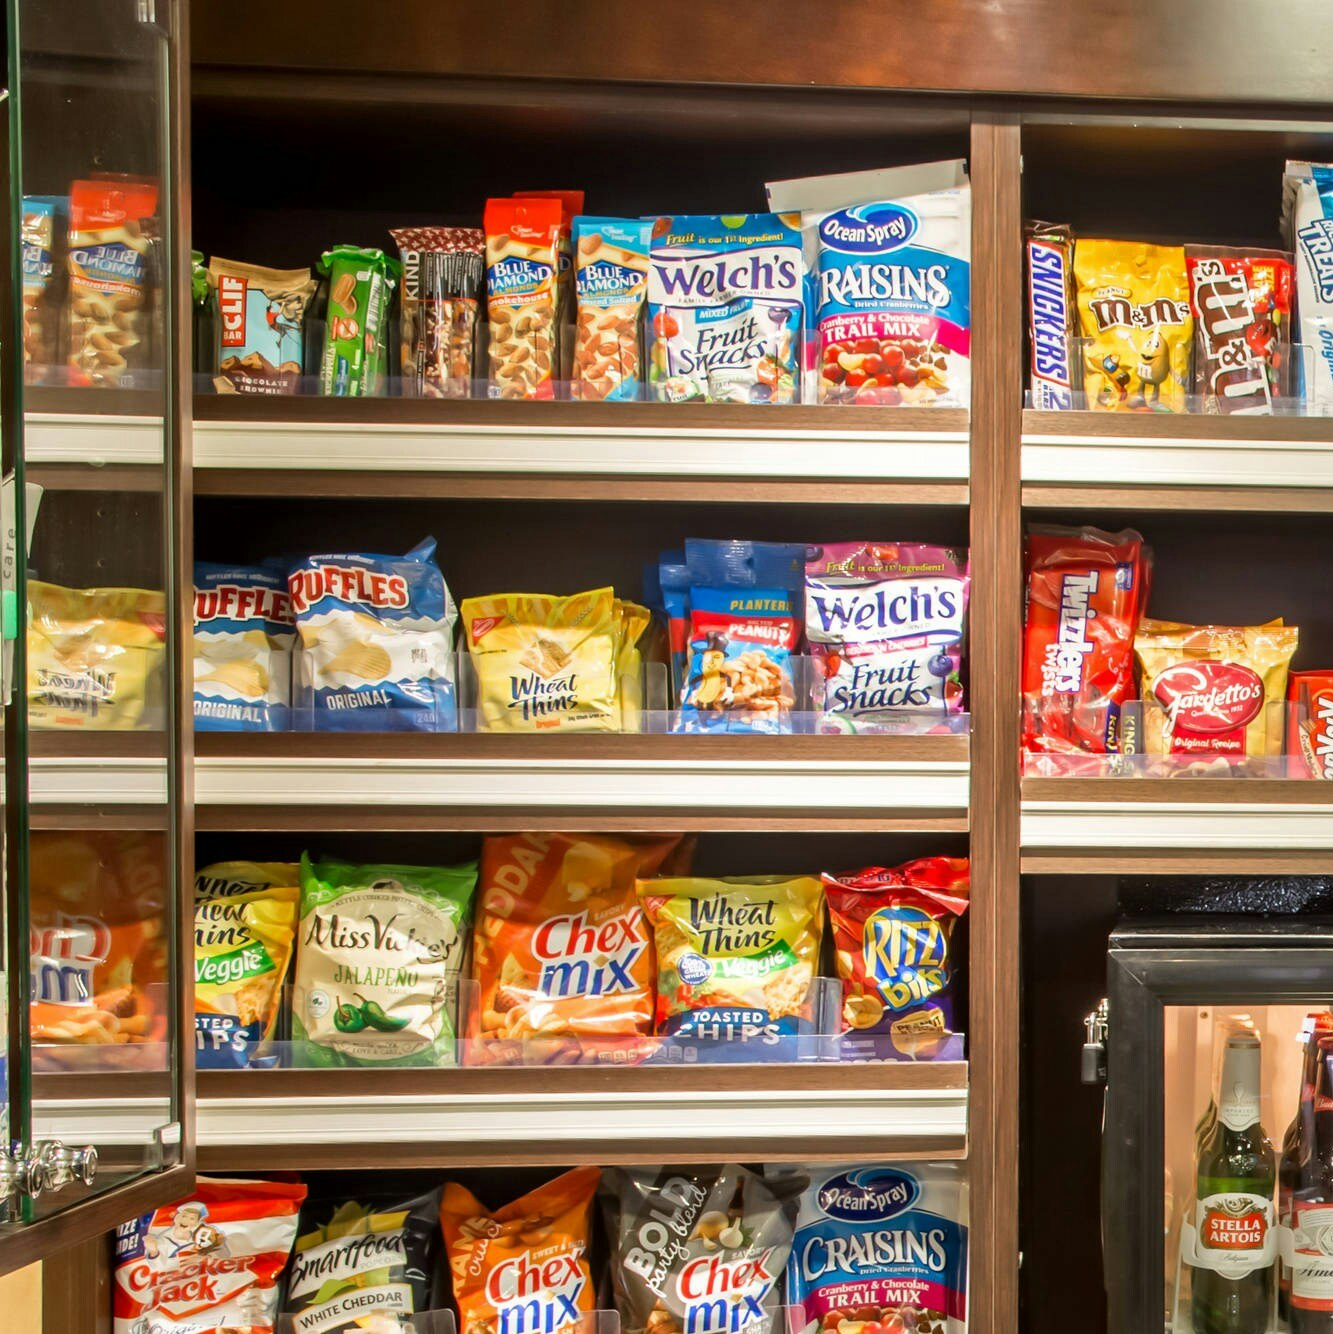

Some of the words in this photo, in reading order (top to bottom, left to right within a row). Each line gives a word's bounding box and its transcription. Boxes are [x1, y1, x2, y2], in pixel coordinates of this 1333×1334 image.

[824, 219, 865, 242] Ocean
[867, 216, 906, 245] Spray
[405, 250, 420, 301] KIND
[495, 262, 531, 277] BLUE
[585, 266, 622, 280] BLUE
[652, 255, 797, 297] Welch's
[222, 277, 243, 329] CLIF
[699, 307, 729, 319] MIXED
[1030, 242, 1068, 381] SNICKERS
[224, 331, 242, 340] BAR
[696, 316, 758, 353] Fruit
[825, 323, 878, 342] TRAIL
[884, 322, 921, 336] MIX
[679, 340, 767, 375] Snacks
[288, 565, 409, 613] RUFFLES
[811, 586, 956, 632] Welch's
[510, 673, 578, 702] Wheat
[851, 659, 920, 690] Fruit
[326, 689, 392, 711] ORIGINAL
[508, 695, 578, 721] Thins
[833, 683, 932, 713] Snacks
[1124, 714, 1136, 755] KING
[1174, 737, 1209, 748] Original
[689, 892, 778, 929] Wheat
[535, 907, 643, 960] Chex
[695, 927, 776, 955] Thins
[543, 947, 641, 997] mix
[692, 1011, 765, 1024] TOASTED
[625, 1176, 692, 1277] BOLD
[1210, 1230, 1261, 1243] ARTOIS
[1211, 1218, 1261, 1232] STELLA
[802, 1228, 948, 1282] CRAISINS
[129, 1255, 256, 1292] Cracker
[488, 1249, 585, 1303] Chex
[679, 1252, 773, 1302] Chex
[818, 1280, 868, 1298] Cranberry
[871, 1280, 880, 1289] &
[882, 1279, 930, 1291] Chocolate
[142, 1274, 223, 1314] Jack
[300, 1305, 341, 1330] WHITE
[342, 1291, 403, 1312] CHEDDAR
[827, 1291, 879, 1308] TRAIL
[886, 1289, 921, 1303] MIX
